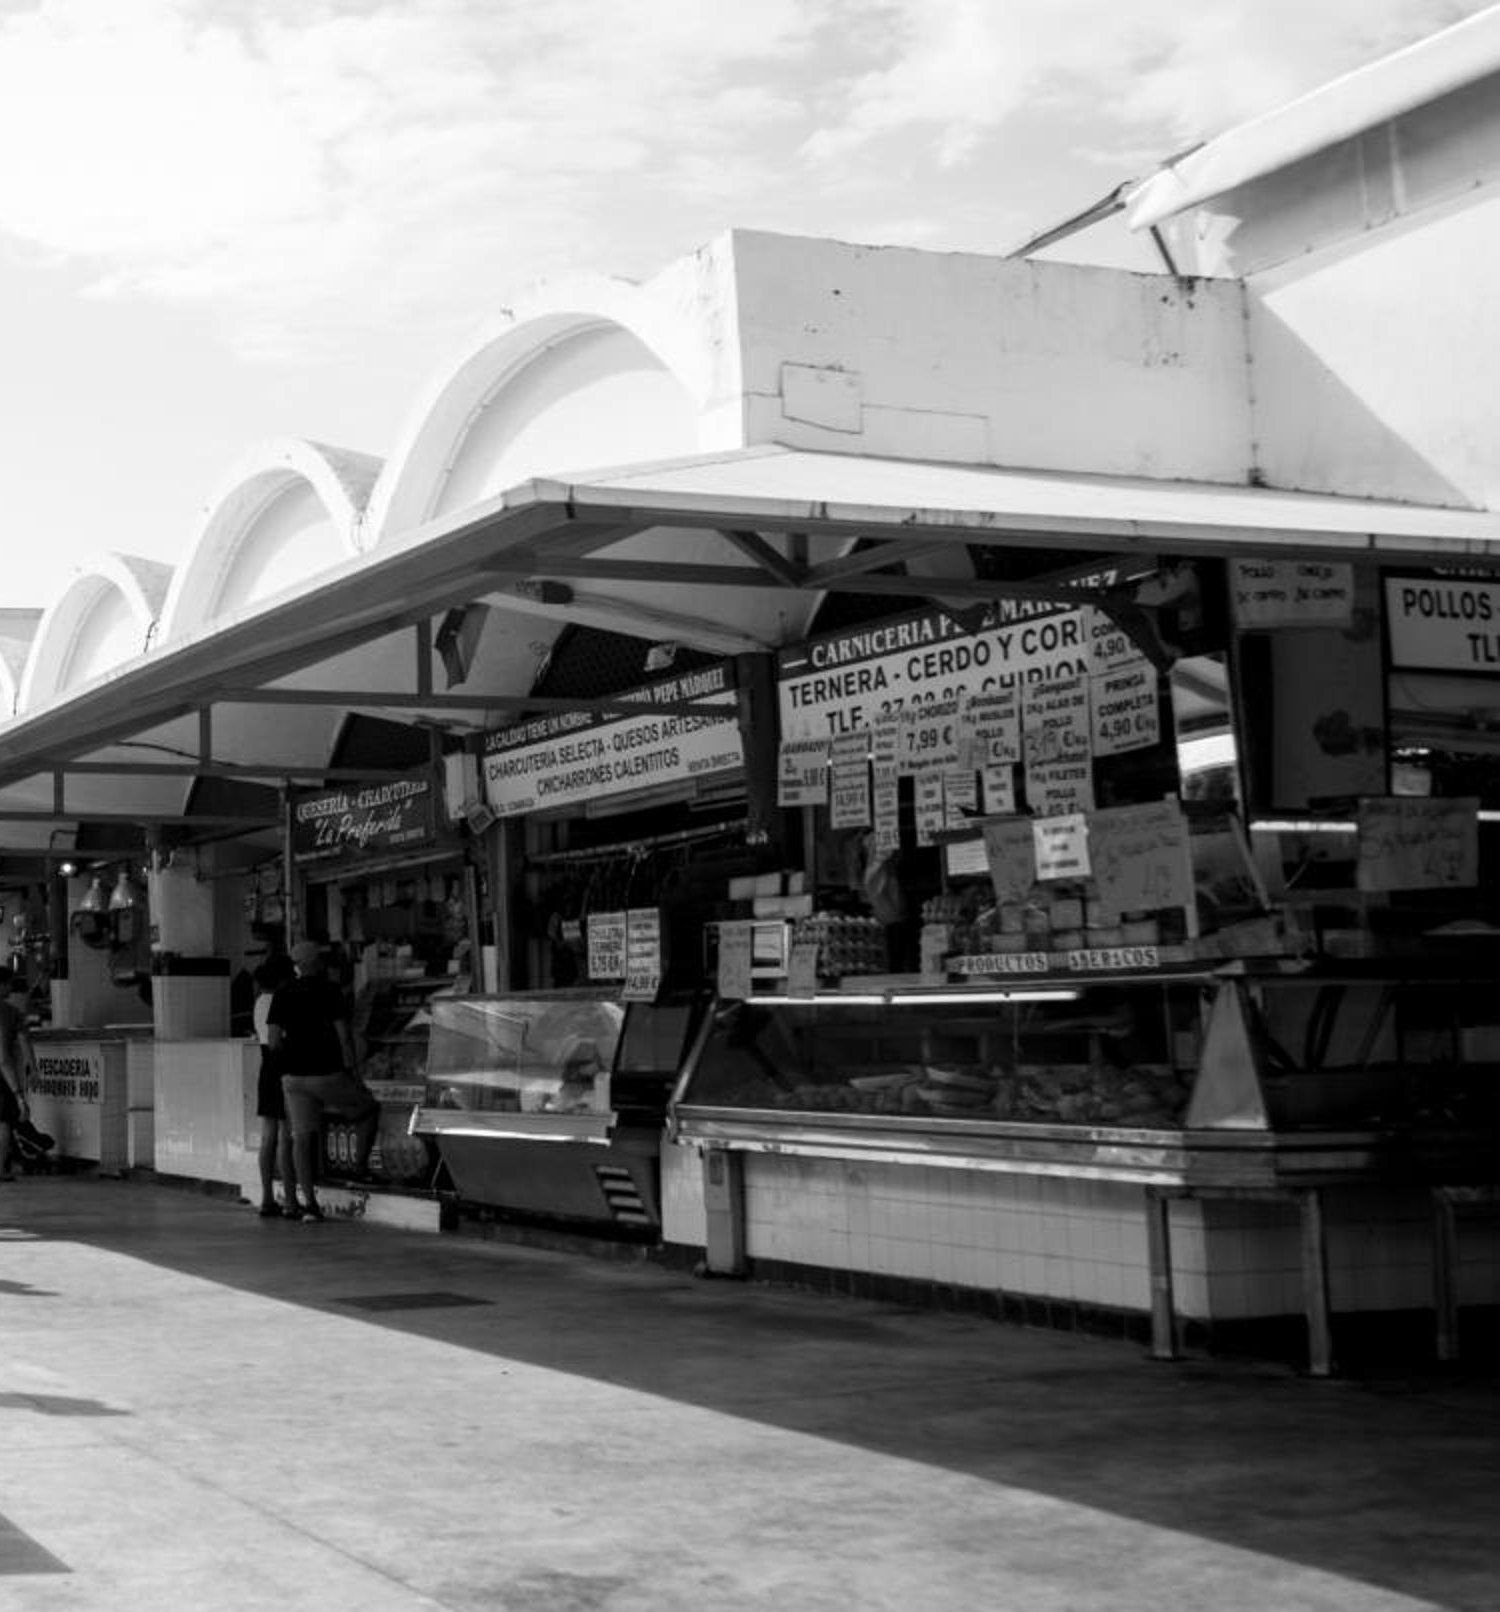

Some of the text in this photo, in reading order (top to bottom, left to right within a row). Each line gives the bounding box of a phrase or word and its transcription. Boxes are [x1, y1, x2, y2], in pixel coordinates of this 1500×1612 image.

[1402, 588, 1493, 621] POLLOS
[810, 619, 933, 668] CARNICERIA
[788, 666, 889, 710] TERNERA
[908, 640, 992, 683] CERDO
[996, 633, 1014, 661] Y
[826, 706, 870, 735] TLF.
[558, 737, 606, 765] SELECTA
[613, 722, 660, 751] QUESOS
[906, 727, 938, 753] 7,99
[537, 747, 681, 797] CHICHARRONES CALENTITOS
[957, 953, 1047, 973] PRODUCTOS
